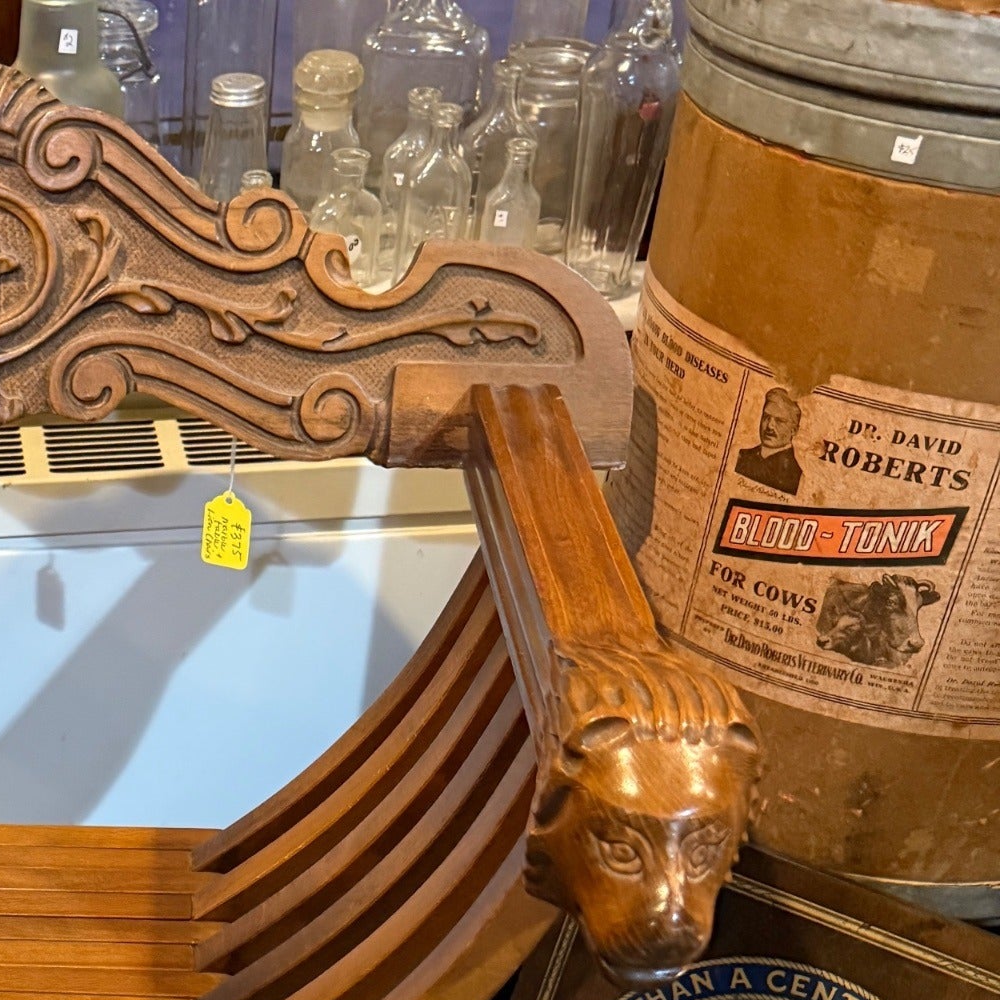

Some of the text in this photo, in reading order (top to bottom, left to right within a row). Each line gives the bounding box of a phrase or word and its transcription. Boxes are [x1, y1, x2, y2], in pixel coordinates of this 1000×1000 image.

[665, 357, 685, 379] HERD
[684, 351, 729, 383] DISEASES
[848, 419, 962, 455] DR. DAVID
[818, 439, 971, 491] ROBERTS
[709, 560, 817, 614] FOR COWS
[712, 585, 728, 598] NET
[731, 594, 767, 613] WEIGHT
[730, 967, 752, 989] A
